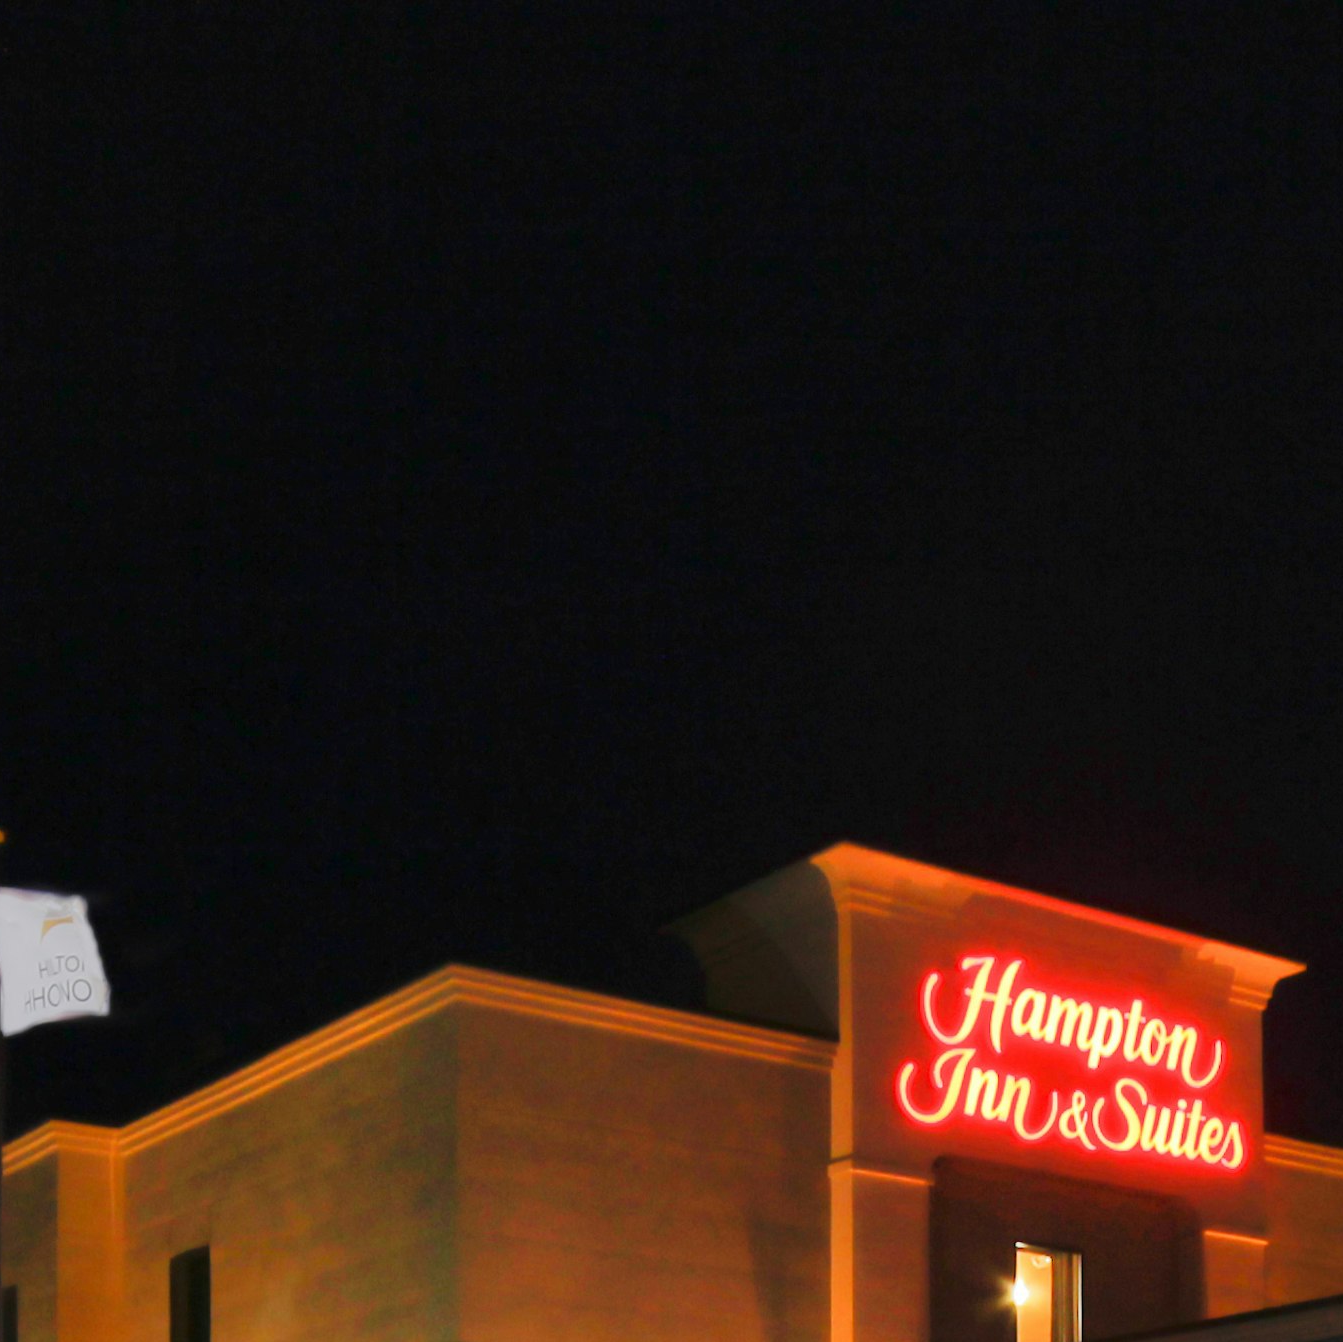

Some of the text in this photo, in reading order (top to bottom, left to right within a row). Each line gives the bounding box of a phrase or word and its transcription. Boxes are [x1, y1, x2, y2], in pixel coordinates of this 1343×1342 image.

[923, 956, 1222, 1088] Hampton
[899, 1048, 1244, 1169] Inn & Suites
